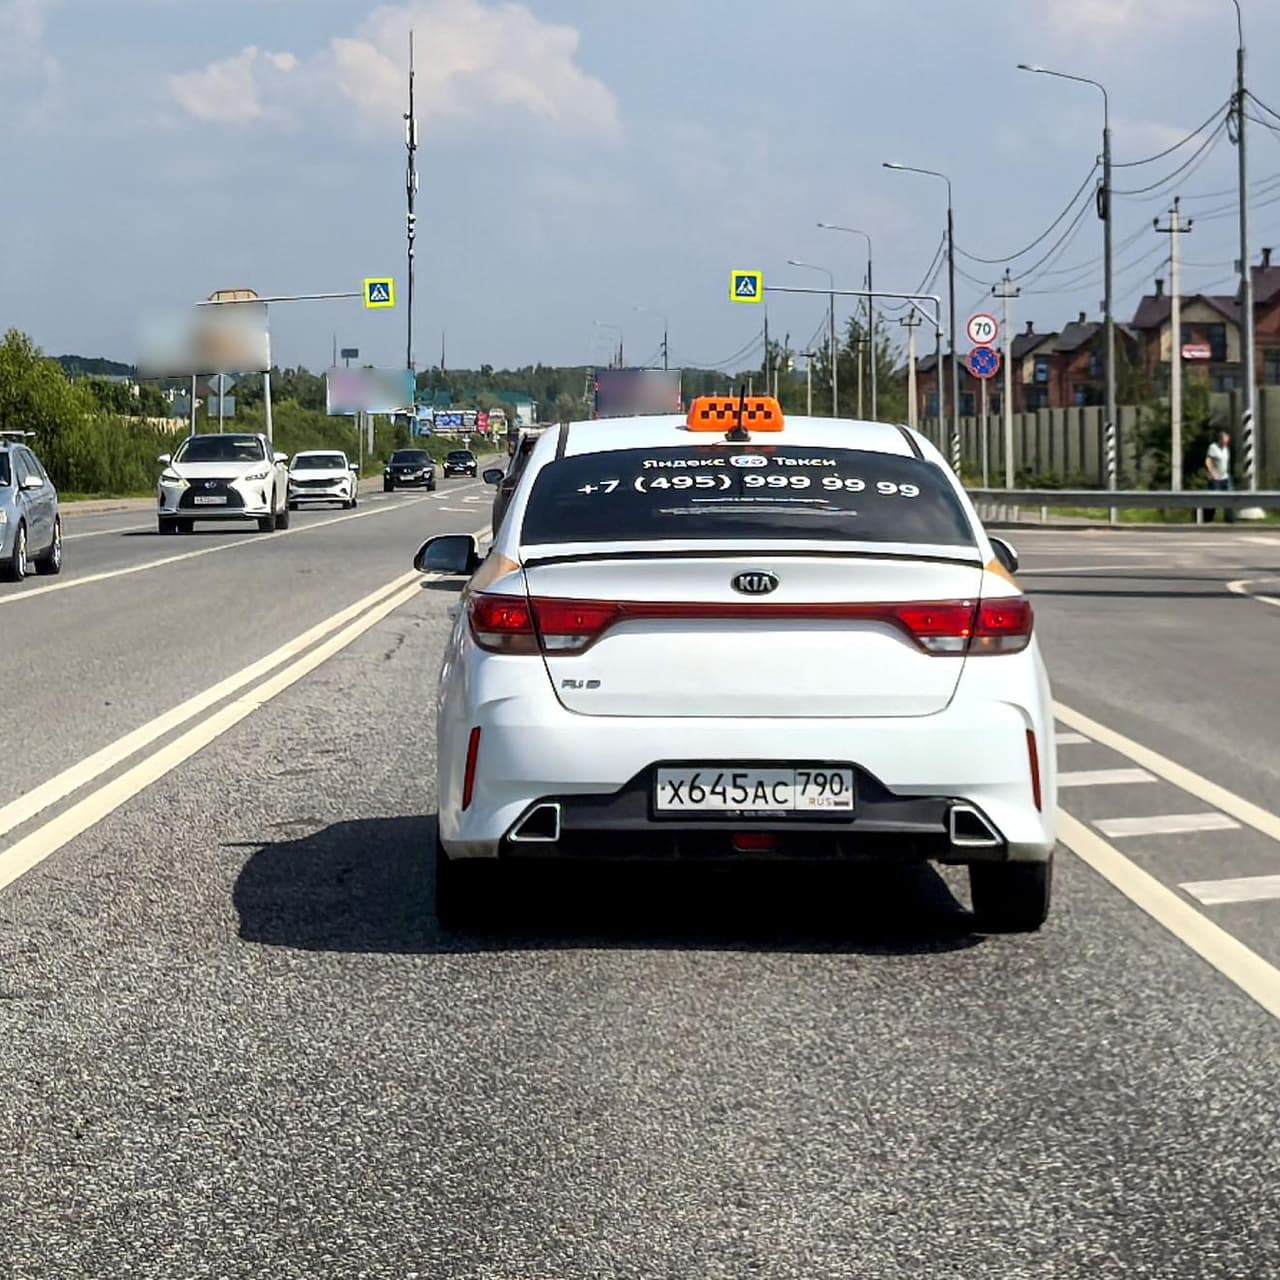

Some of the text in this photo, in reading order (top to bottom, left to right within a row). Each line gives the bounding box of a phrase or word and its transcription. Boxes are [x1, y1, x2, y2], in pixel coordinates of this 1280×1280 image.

[974, 322, 992, 336] 70
[642, 456, 837, 470] Яндекс Такси
[577, 474, 921, 498] +7 (495) 999 99 99
[738, 576, 773, 591] KIA
[669, 772, 844, 805] Х645АС 790
[809, 797, 832, 806] RUS
